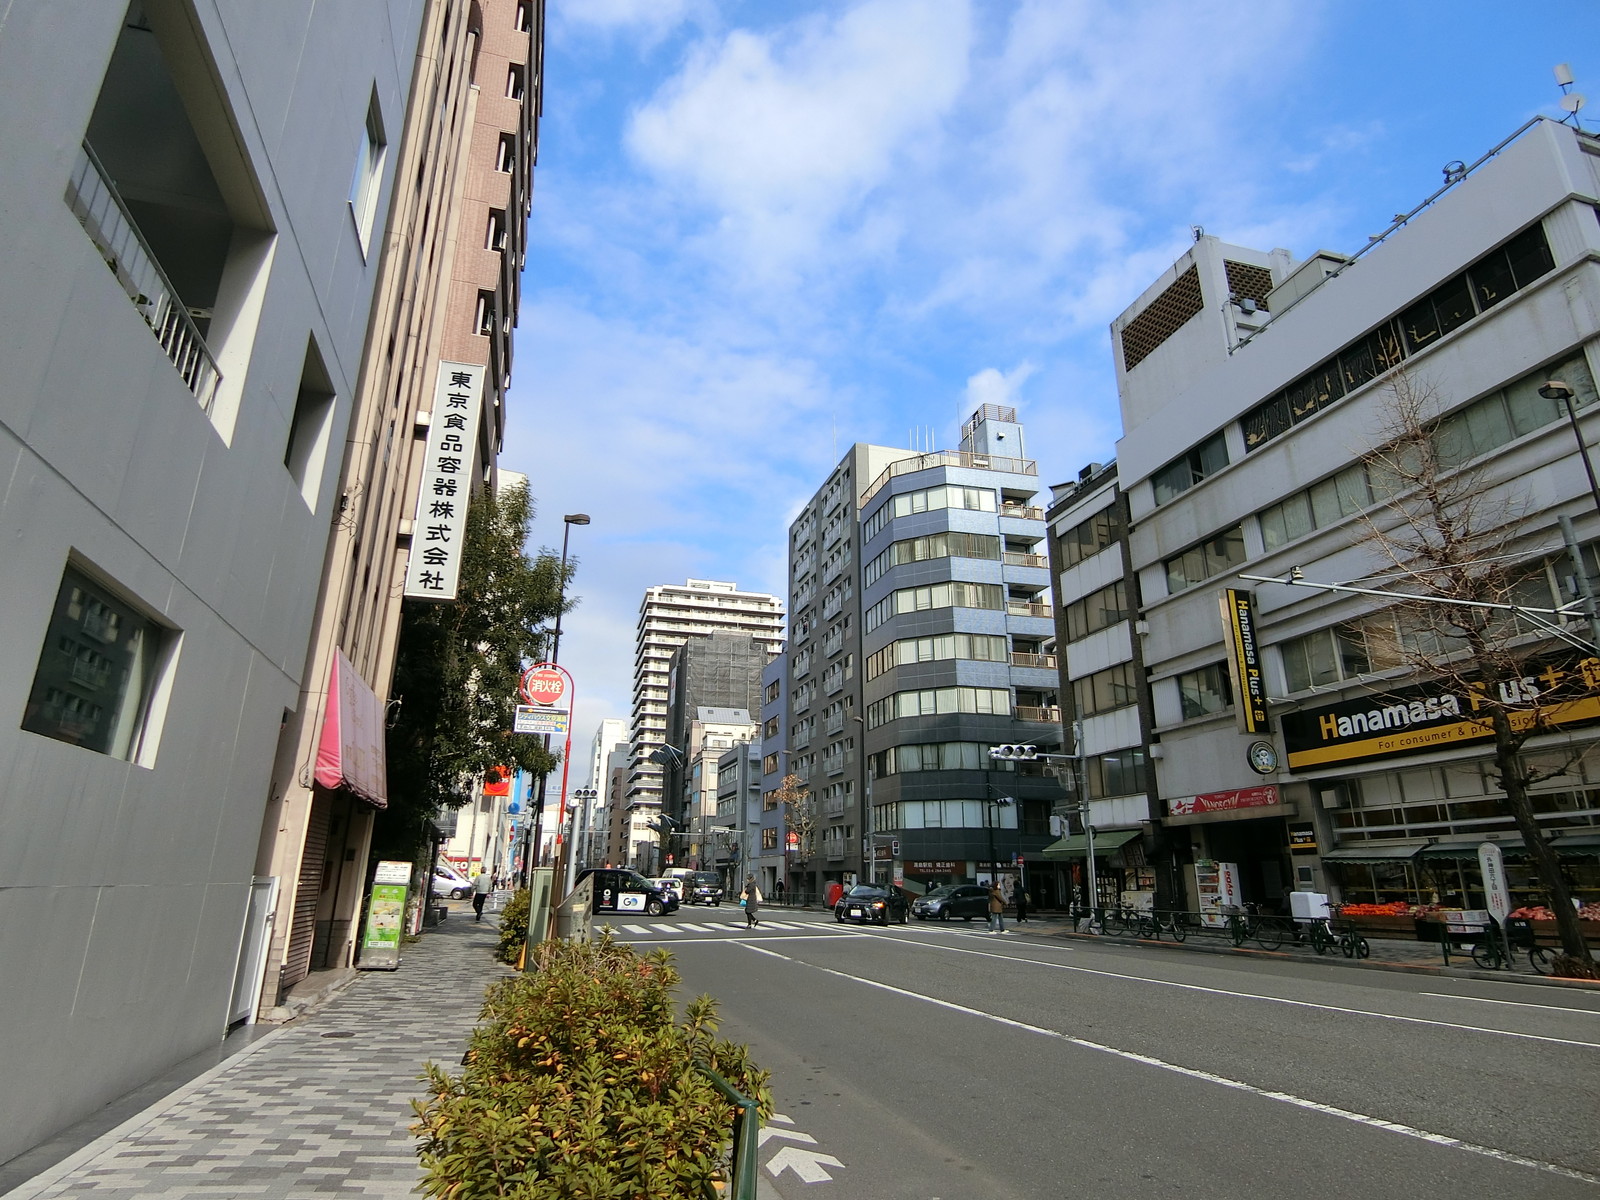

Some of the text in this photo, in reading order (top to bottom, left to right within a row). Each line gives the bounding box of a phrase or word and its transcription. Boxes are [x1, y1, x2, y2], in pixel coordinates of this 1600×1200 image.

[418, 370, 473, 591] 東京食品容器株式会社
[1237, 600, 1255, 664] Hanamasa
[531, 679, 562, 693] 消火栓
[1318, 665, 1564, 740] Hanamasa Pus+
[1378, 739, 1395, 749] For
[1400, 730, 1451, 746] consumer
[1457, 726, 1465, 736] &
[623, 897, 638, 907] GO
